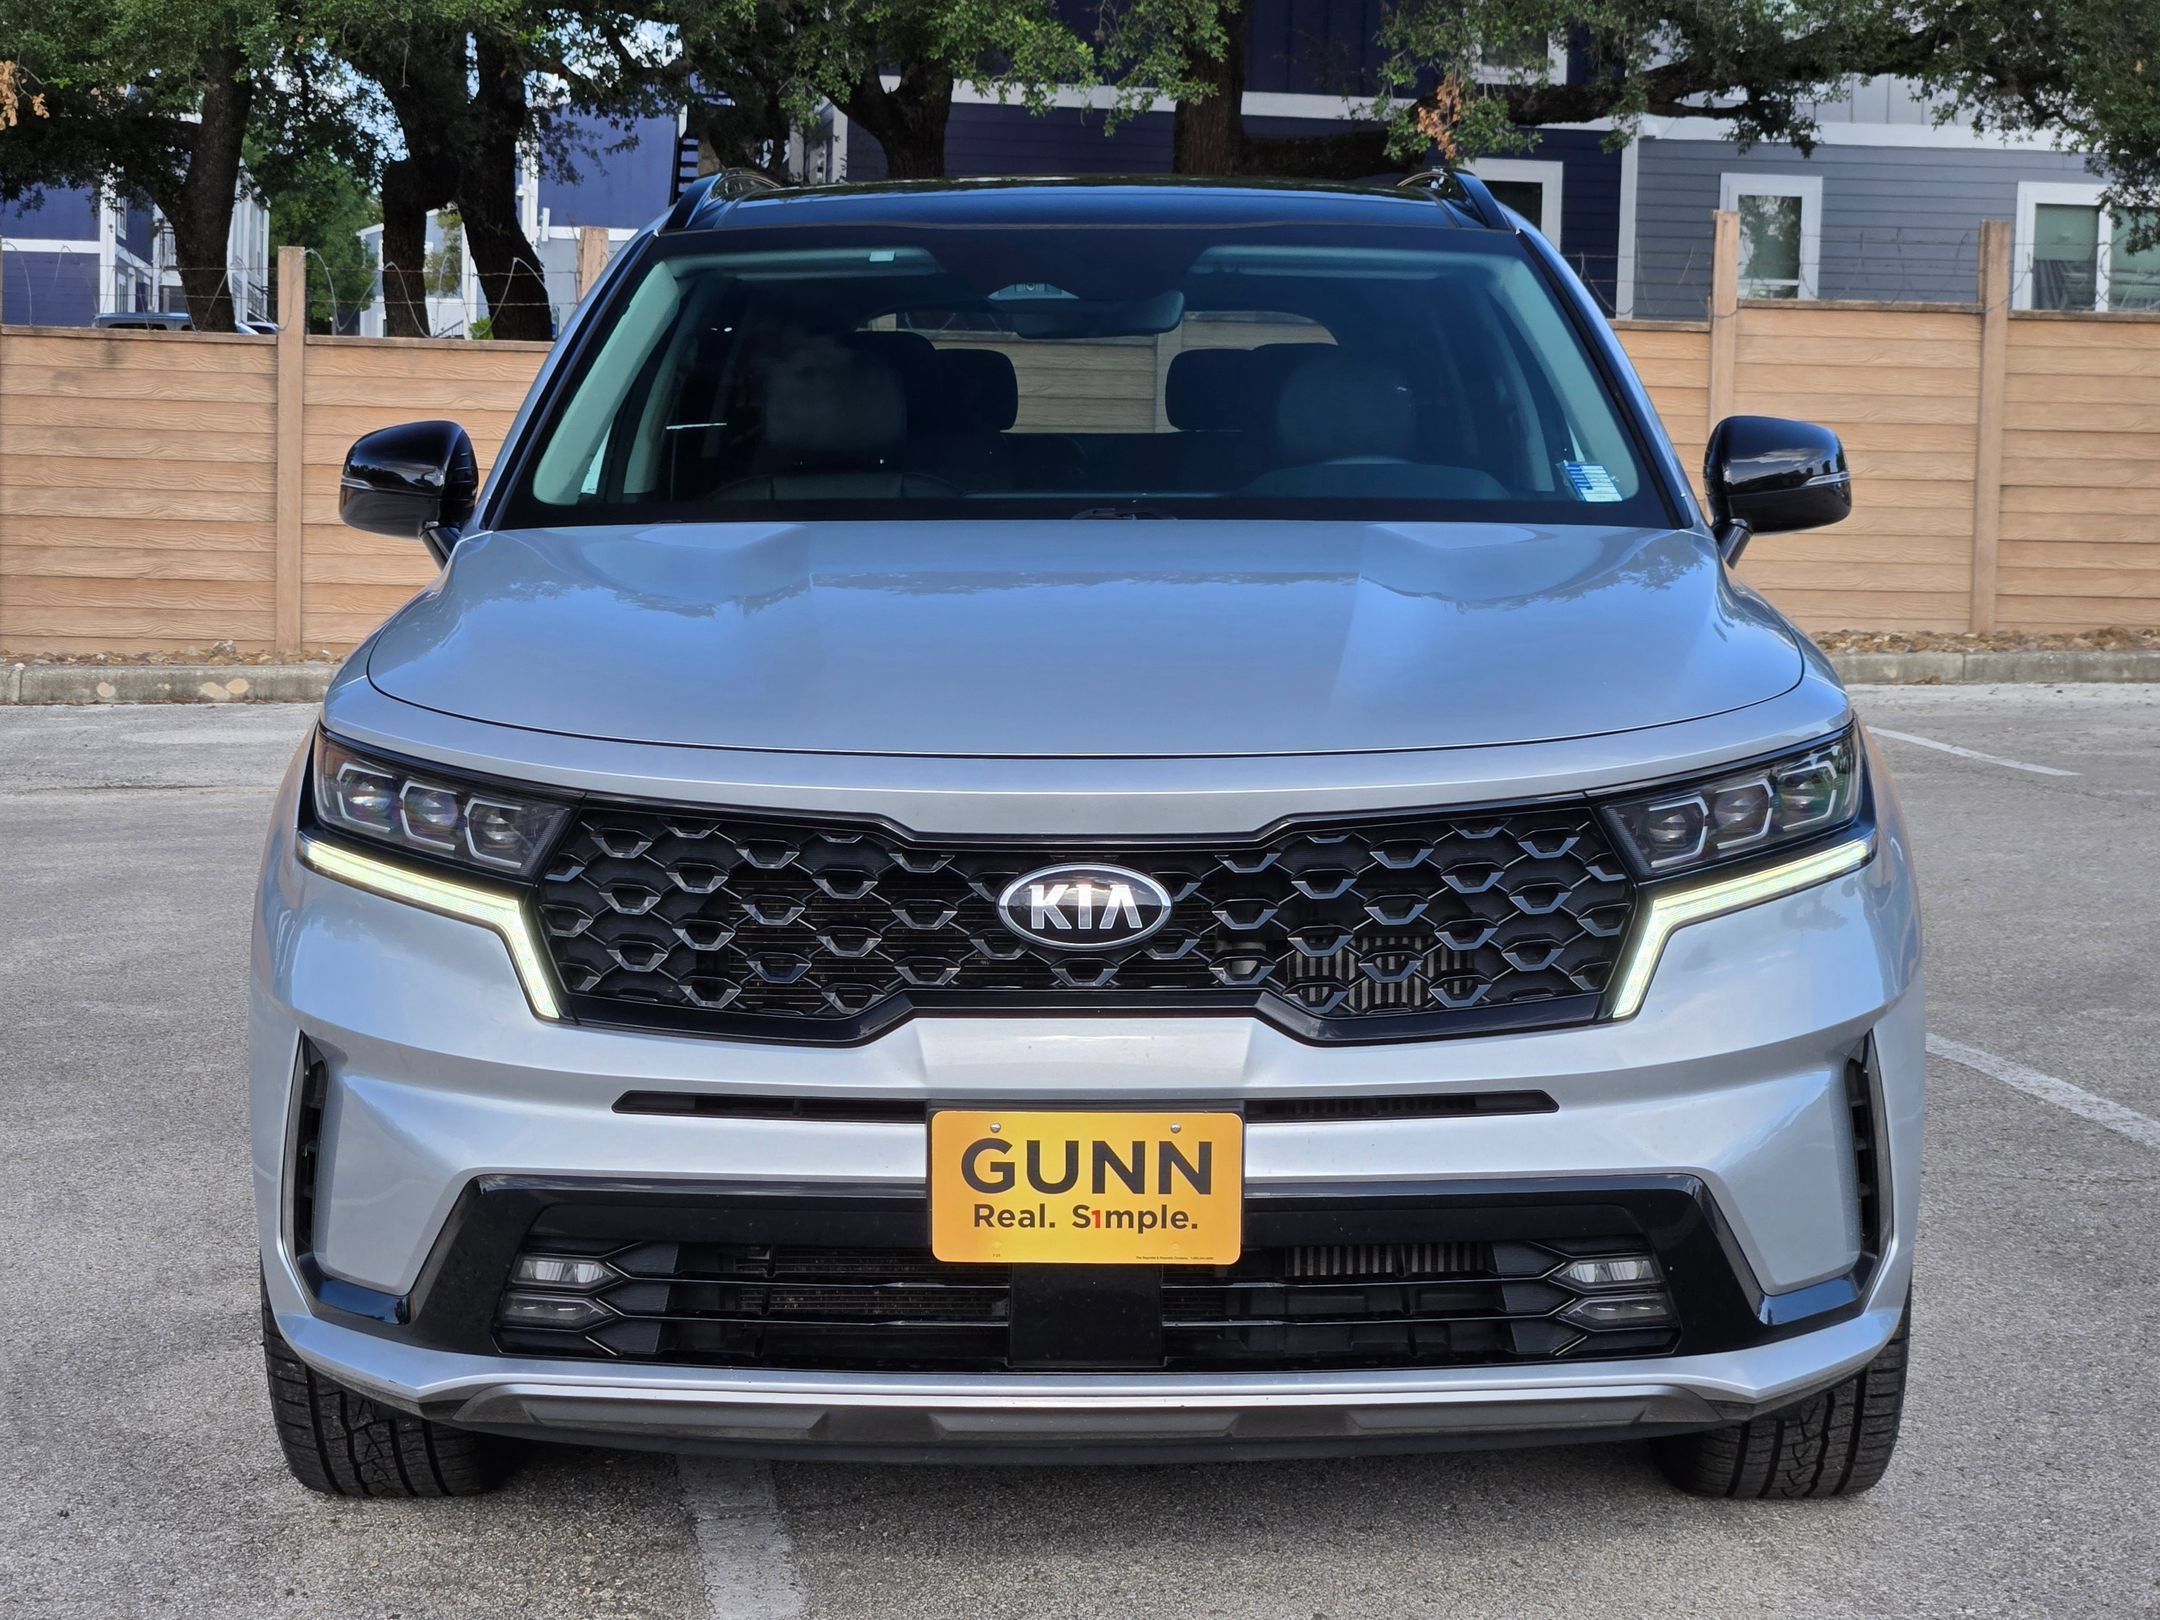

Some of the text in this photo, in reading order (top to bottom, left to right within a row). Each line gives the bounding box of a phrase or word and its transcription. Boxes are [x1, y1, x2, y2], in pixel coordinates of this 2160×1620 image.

[1029, 884, 1143, 930] KIA
[961, 1137, 1213, 1195] GUNN
[973, 1203, 1056, 1229] Real.
